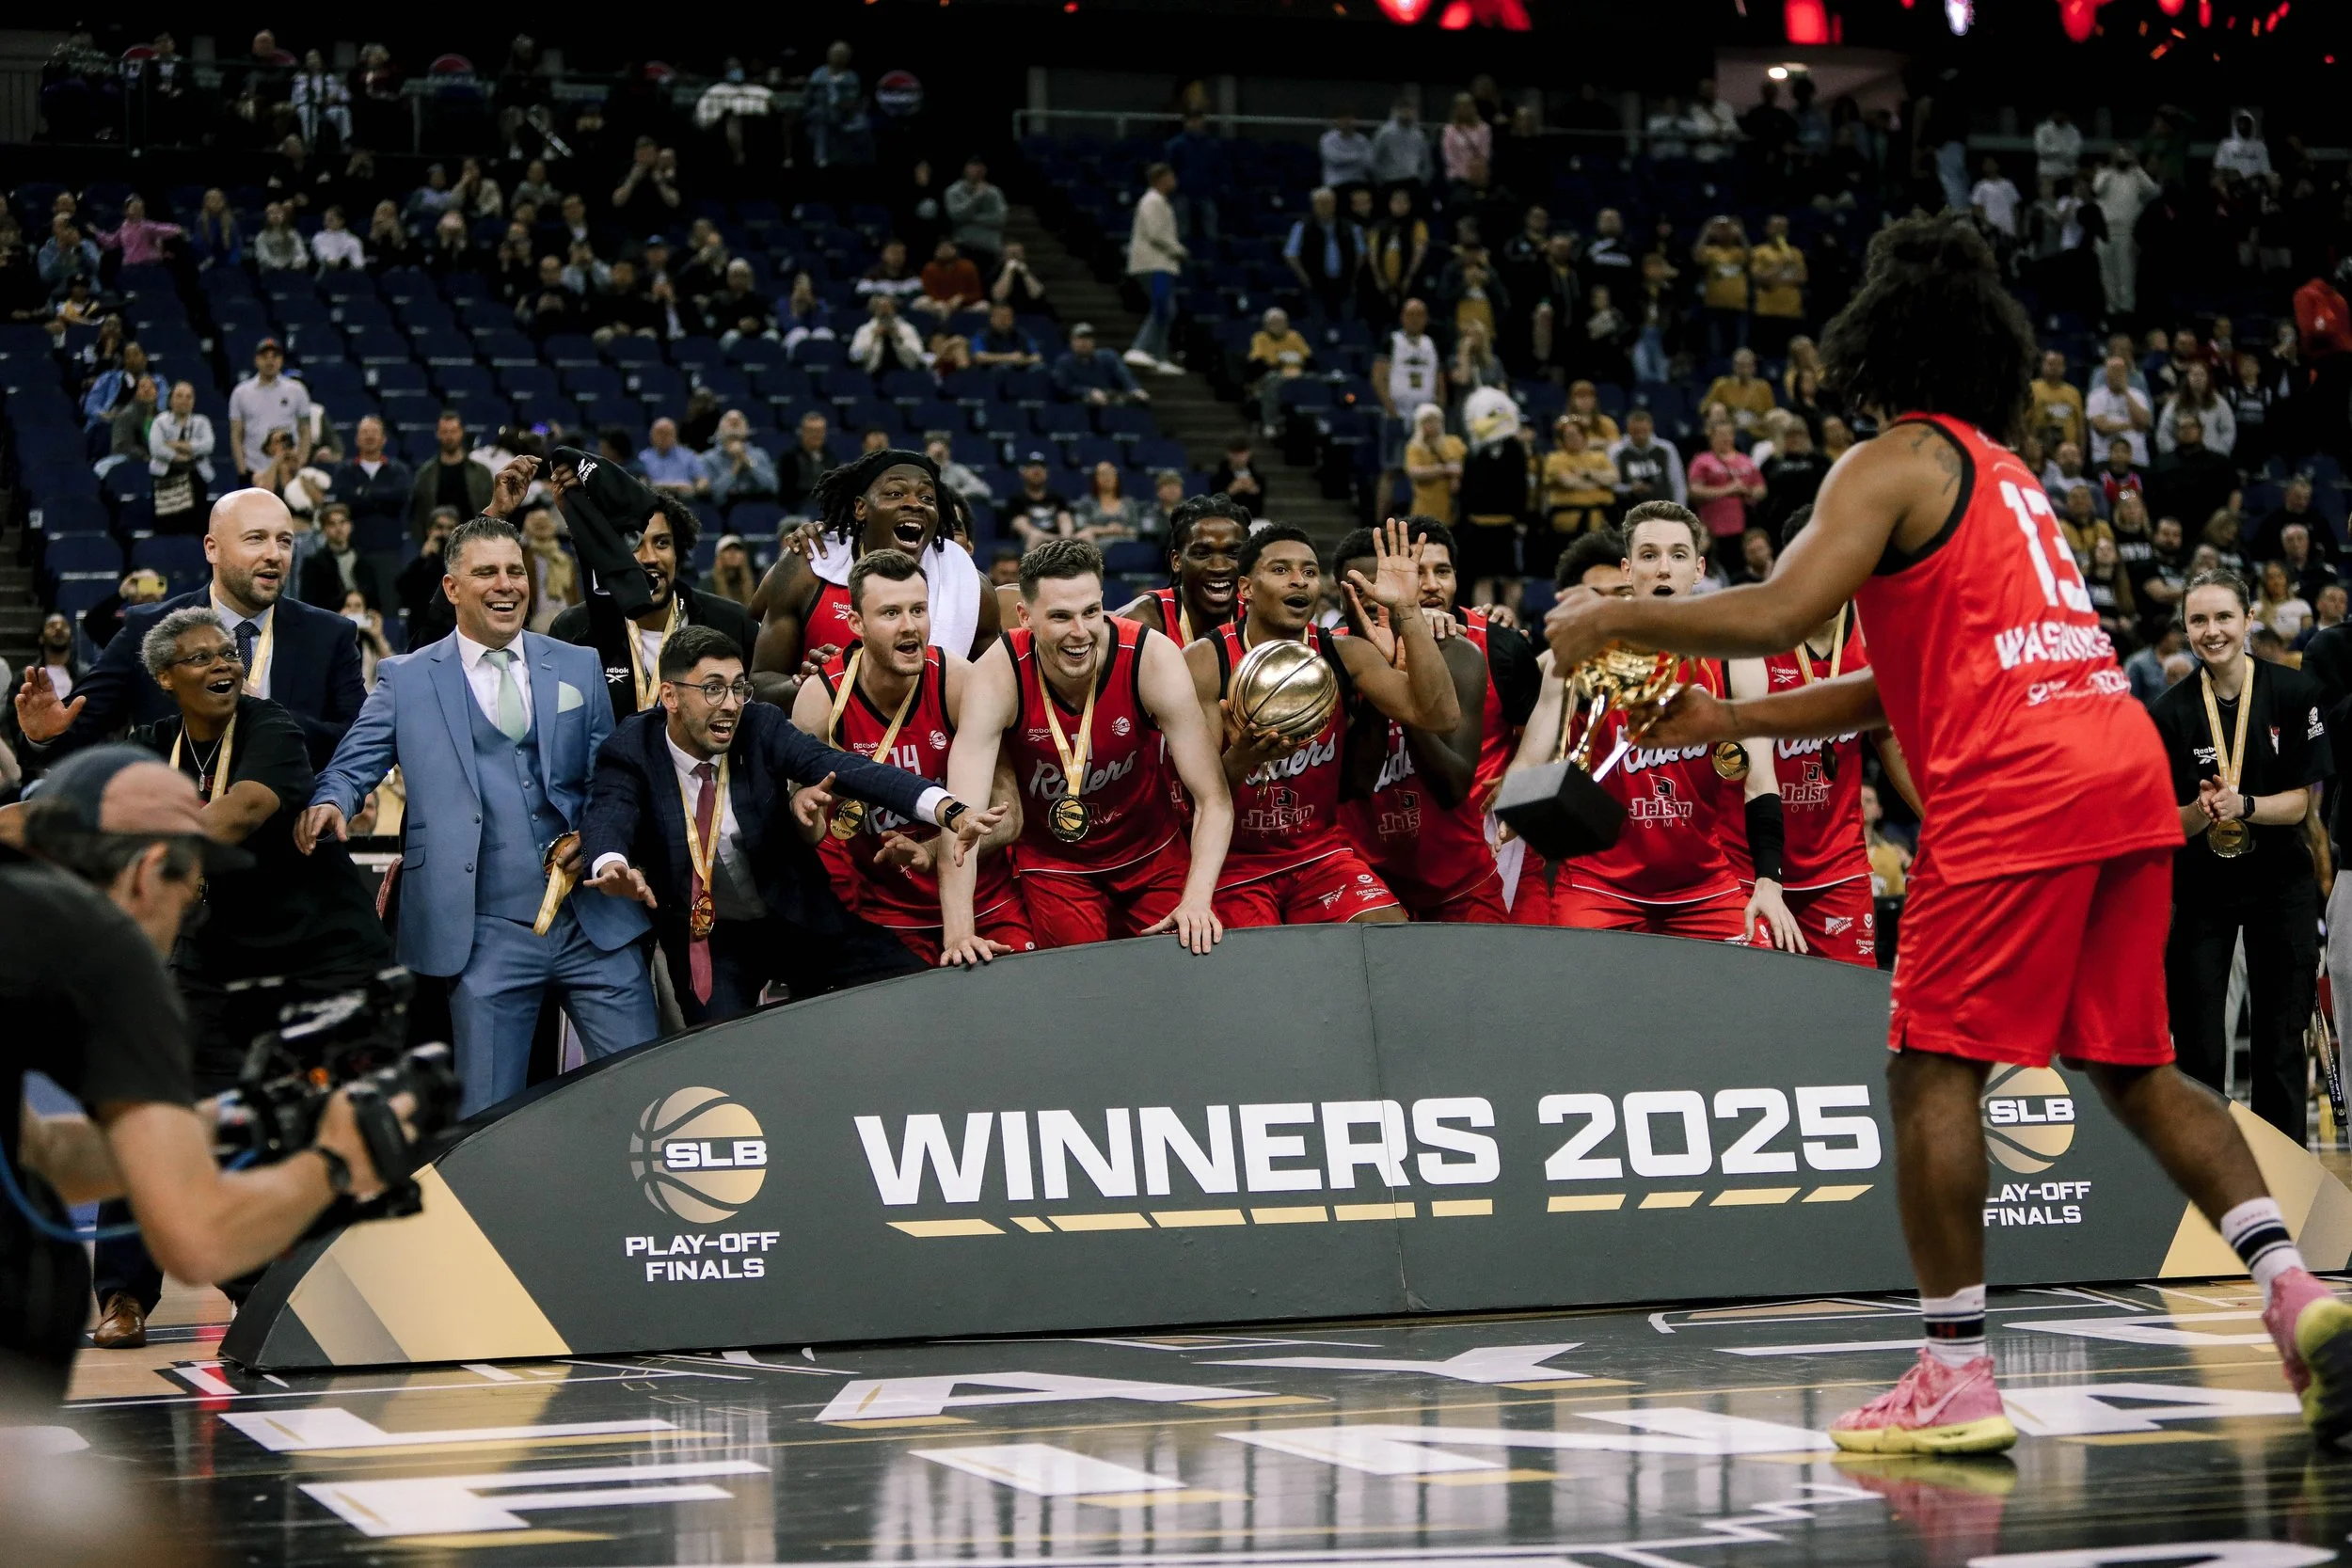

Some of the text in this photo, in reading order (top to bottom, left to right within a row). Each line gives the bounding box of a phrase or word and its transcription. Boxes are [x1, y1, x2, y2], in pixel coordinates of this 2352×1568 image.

[1999, 481, 2093, 613] 13
[833, 602, 852, 610] Reeb
[1772, 666, 1799, 675] Reebok
[890, 744, 922, 776] 14
[2193, 746, 2217, 756] Reeb
[1988, 1098, 2075, 1124] SLB
[665, 1140, 768, 1168] SLB
[854, 1085, 1883, 1206] WINNERS 2025
[1985, 1180, 2091, 1203] AY-OFF
[1983, 1205, 2082, 1227] FINALS
[625, 1231, 780, 1257] PLAY-OFF
[645, 1258, 765, 1282] FINALS
